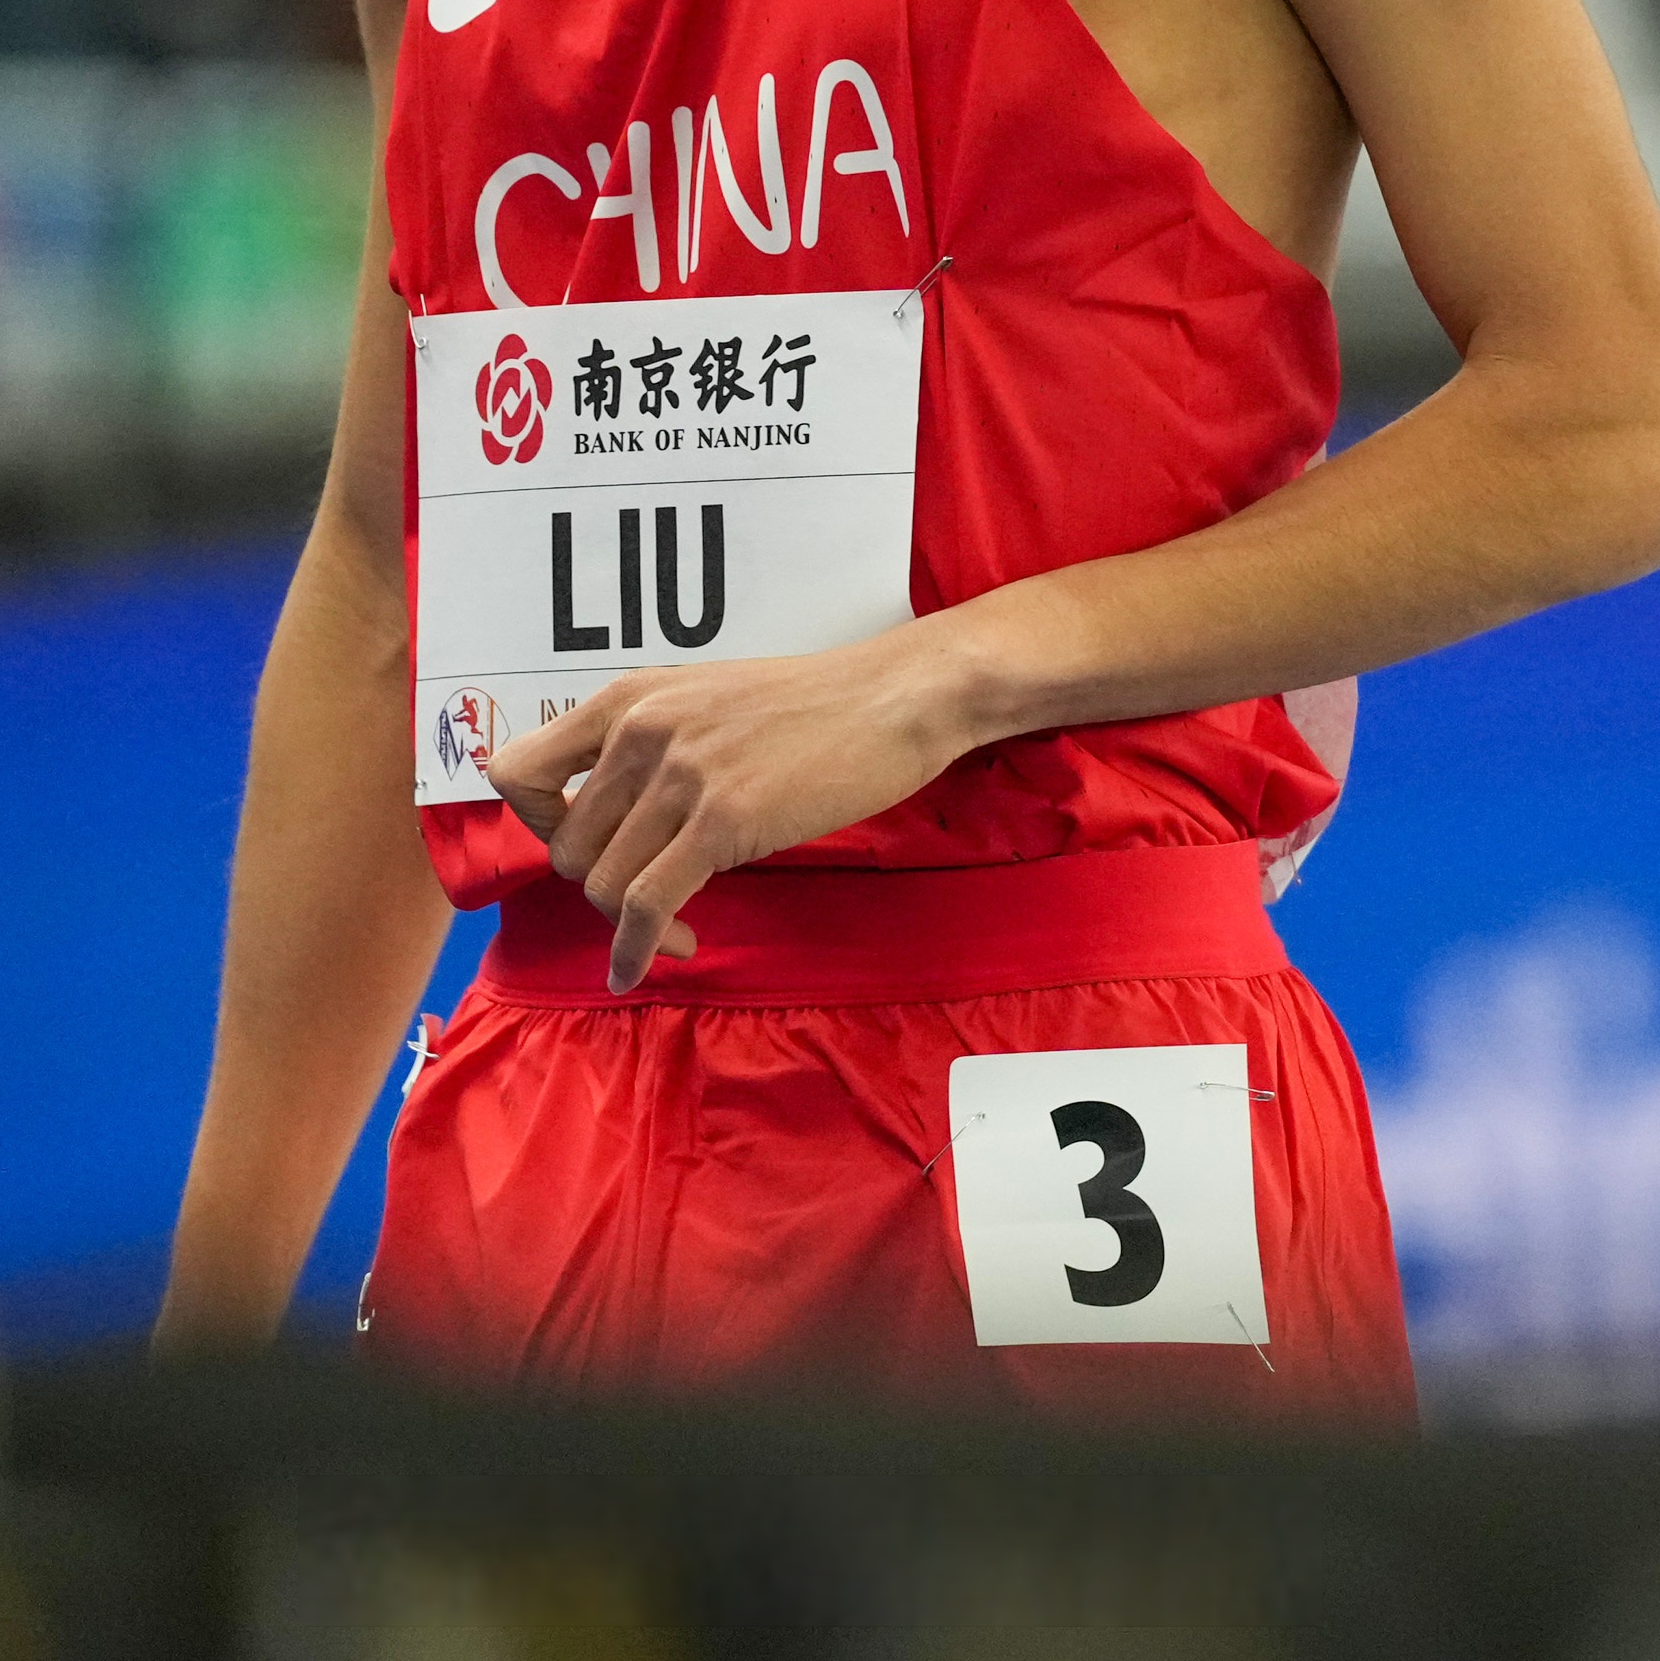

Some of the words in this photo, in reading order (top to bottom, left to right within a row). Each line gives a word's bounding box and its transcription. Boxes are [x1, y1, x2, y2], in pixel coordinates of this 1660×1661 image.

[475, 59, 910, 307] CHINA
[573, 334, 816, 421] 南京银行
[573, 430, 644, 455] BANK
[655, 428, 685, 450] OF
[696, 422, 811, 451] NANJING
[551, 504, 726, 652] LIU
[1050, 1100, 1165, 1307] 3
